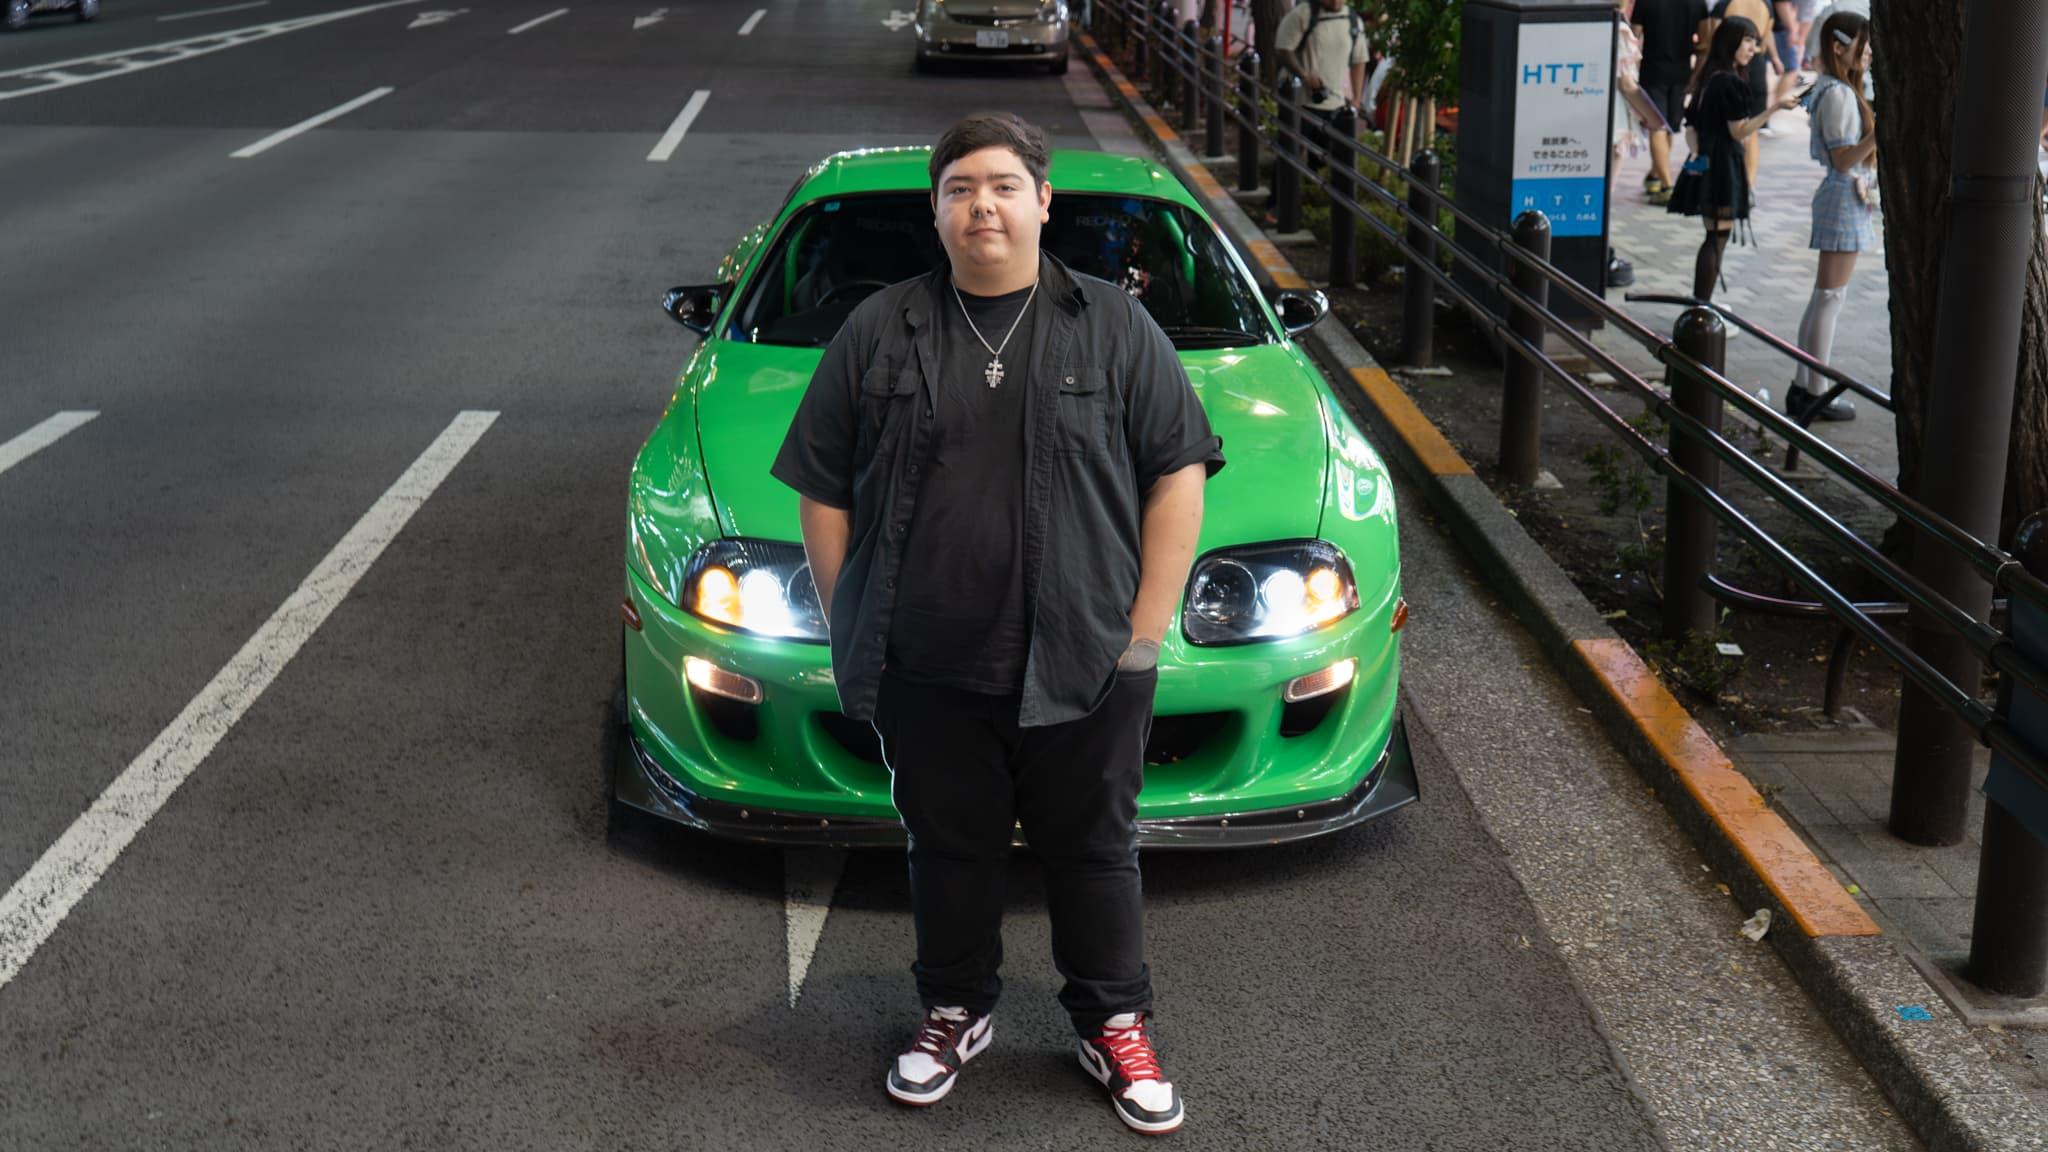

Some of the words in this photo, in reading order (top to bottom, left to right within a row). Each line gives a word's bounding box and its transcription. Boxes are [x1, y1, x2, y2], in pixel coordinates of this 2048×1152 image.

[1523, 63, 1584, 84] HTT
[1524, 196, 1534, 207] H
[1554, 195, 1562, 207] T
[1584, 194, 1591, 206] T
